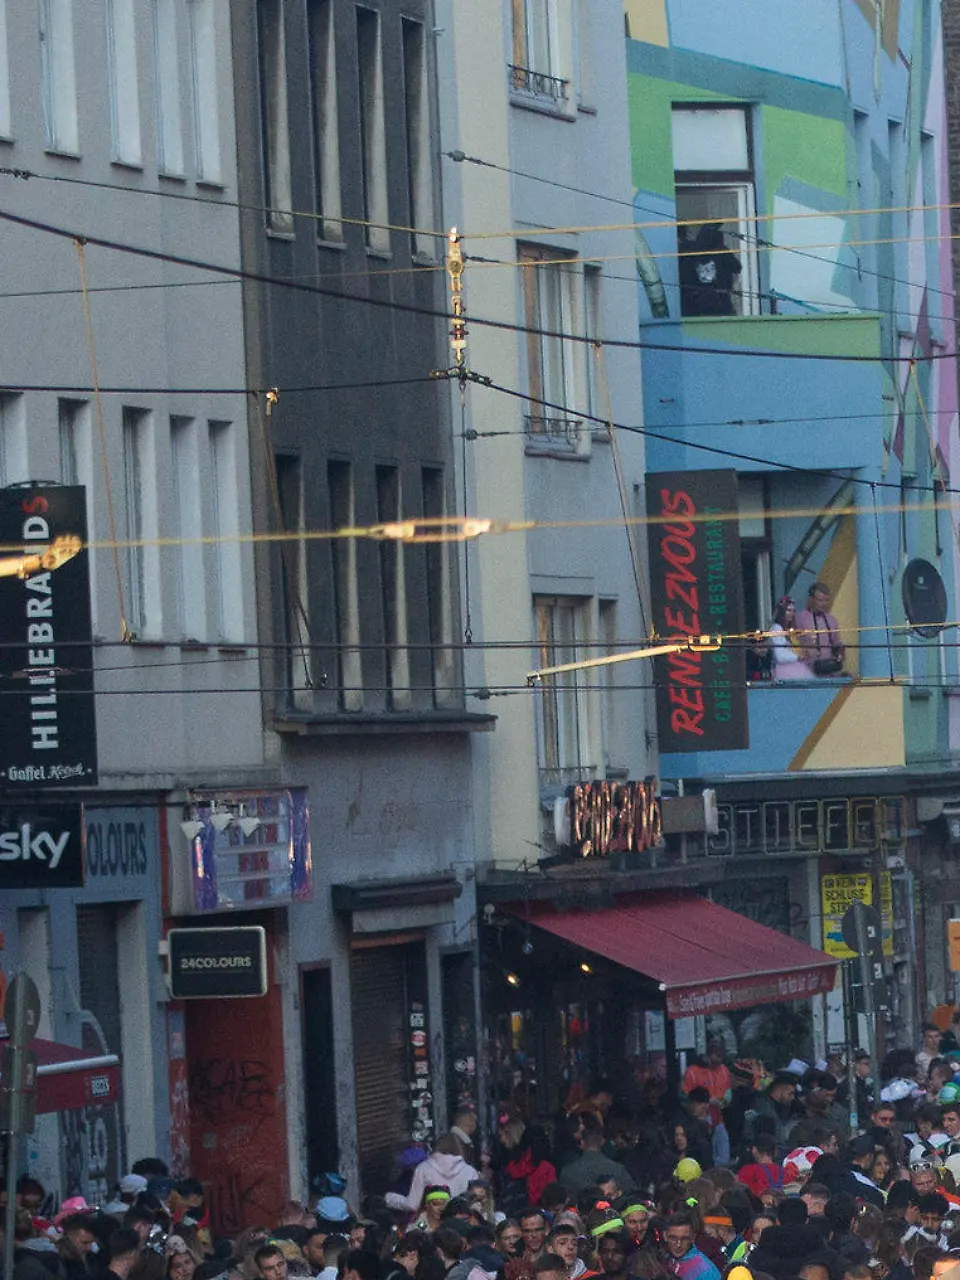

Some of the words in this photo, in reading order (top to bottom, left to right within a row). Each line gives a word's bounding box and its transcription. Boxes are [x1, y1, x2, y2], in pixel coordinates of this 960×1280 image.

[0, 823, 70, 869] sky
[86, 821, 149, 877] OLOURS
[181, 956, 252, 970] 24COLOURS
